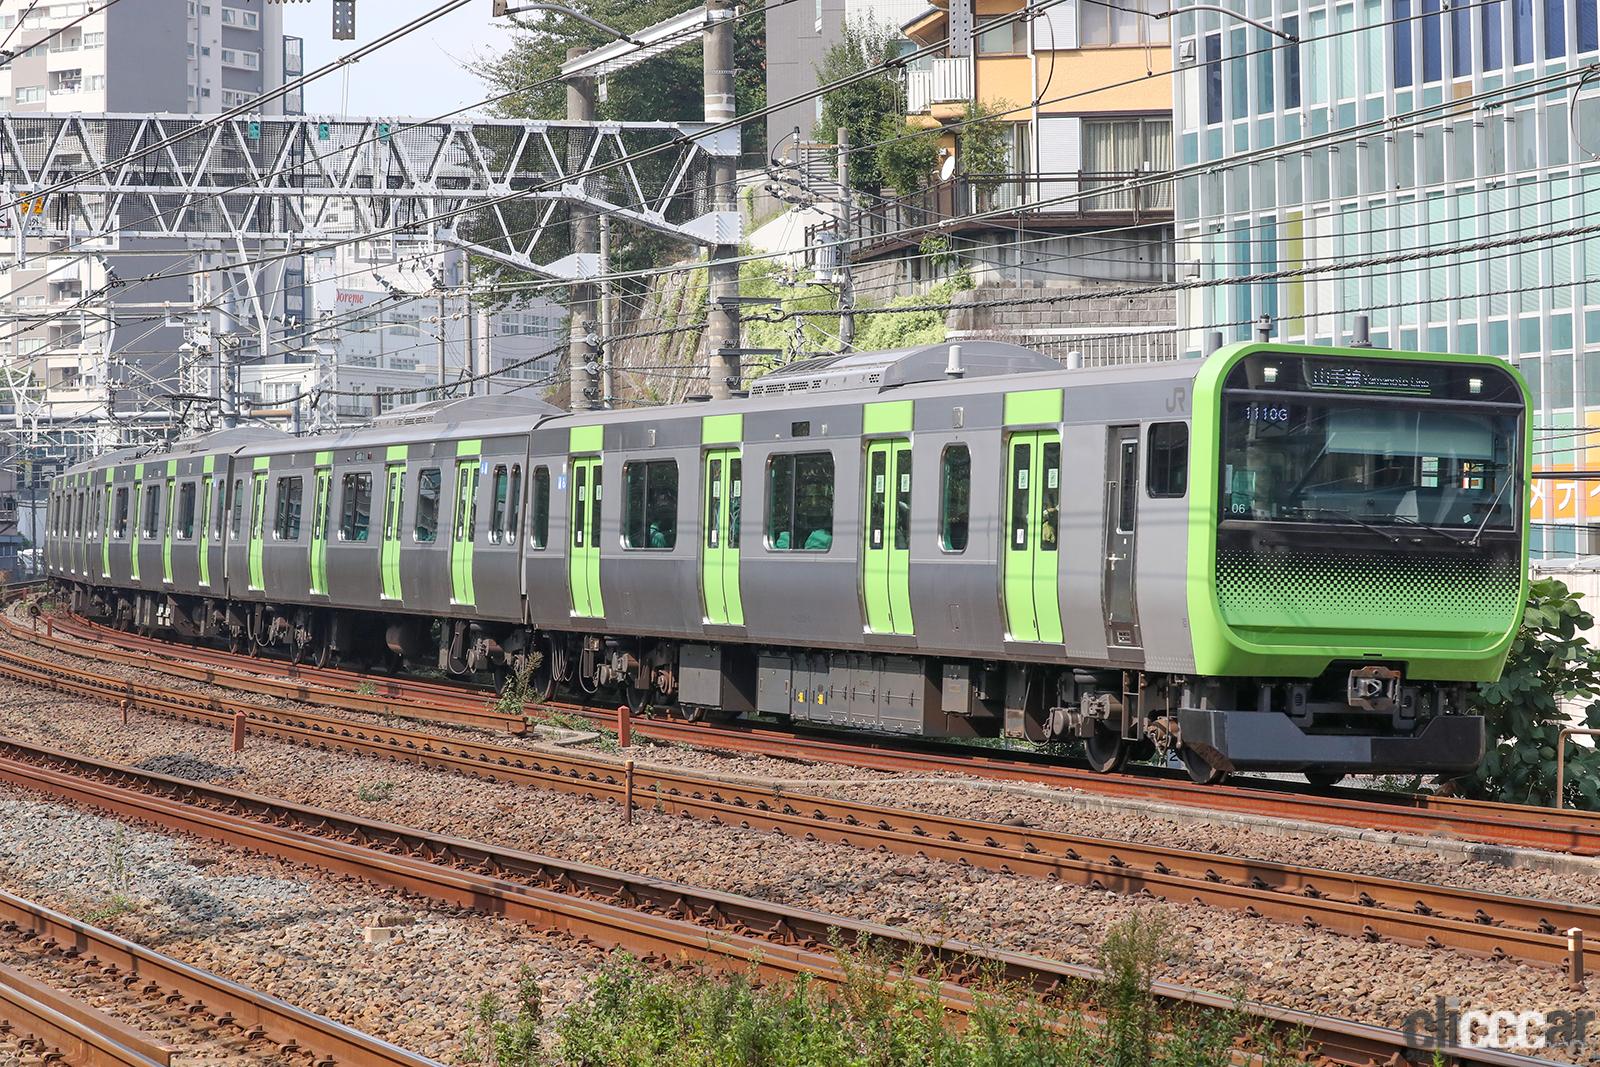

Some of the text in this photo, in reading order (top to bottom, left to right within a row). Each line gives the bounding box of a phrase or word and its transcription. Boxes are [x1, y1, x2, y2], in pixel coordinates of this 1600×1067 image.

[1166, 387, 1185, 412] JR
[1246, 406, 1288, 420] 1110G
[1231, 503, 1246, 513] 06
